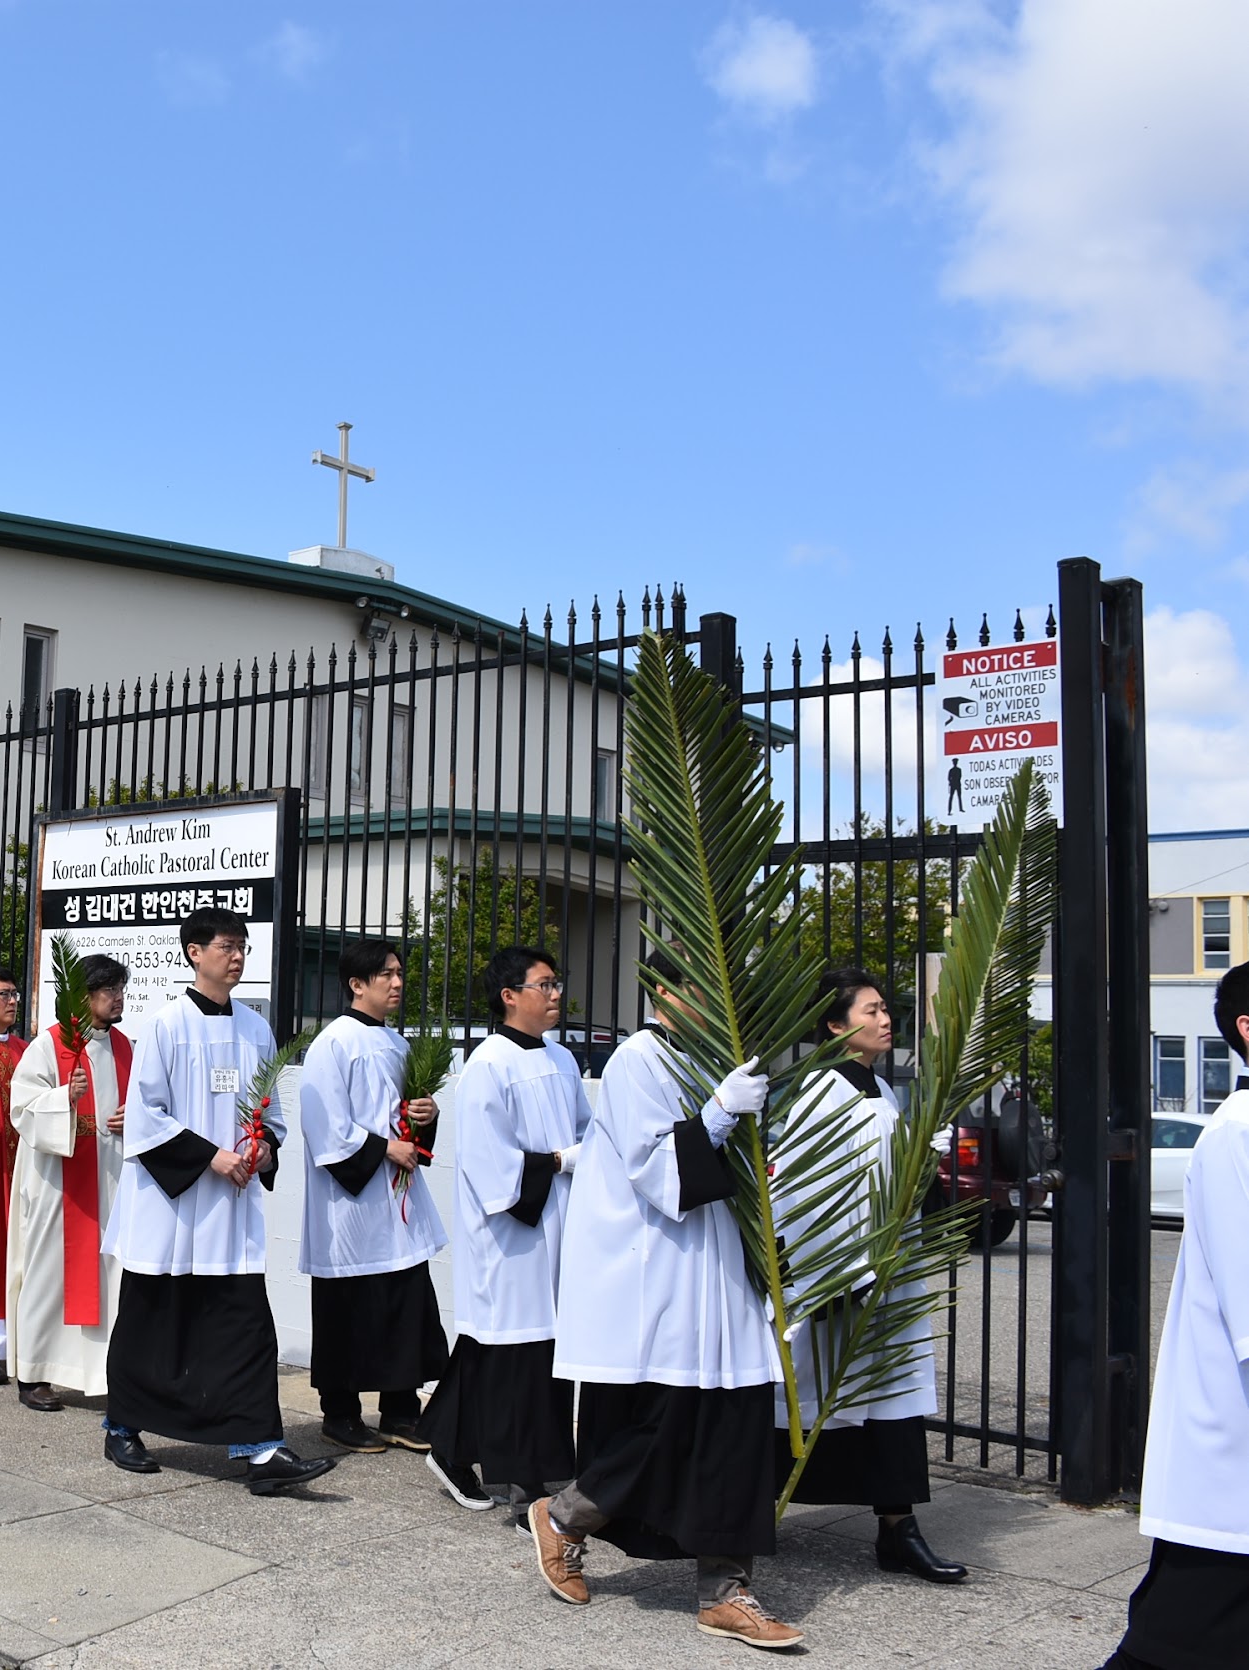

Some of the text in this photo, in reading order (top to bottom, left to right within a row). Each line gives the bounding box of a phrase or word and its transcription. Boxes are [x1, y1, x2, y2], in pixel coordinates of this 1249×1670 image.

[962, 650, 1036, 675] NOTICE
[970, 669, 1057, 689] ALL ACTIVITIES
[979, 683, 1046, 700] MONITORED
[986, 697, 1040, 713] BY VIDEO
[985, 710, 1041, 725] CAMERAS
[969, 730, 1032, 751] AVISO
[969, 760, 996, 772] TODAS
[964, 779, 981, 790] SON
[105, 818, 211, 847] St. Andrew Kim
[52, 847, 269, 880] Korean Catholic Pastoral Center
[64, 895, 80, 922] 성
[85, 892, 136, 921] 김대건
[75, 934, 181, 947] 6226 Camden St. Oaklan
[133, 976, 168, 986] 미사 시간
[127, 993, 137, 1001] Fri.
[138, 993, 150, 1001] Sat.
[130, 1005, 144, 1013] 7:30
